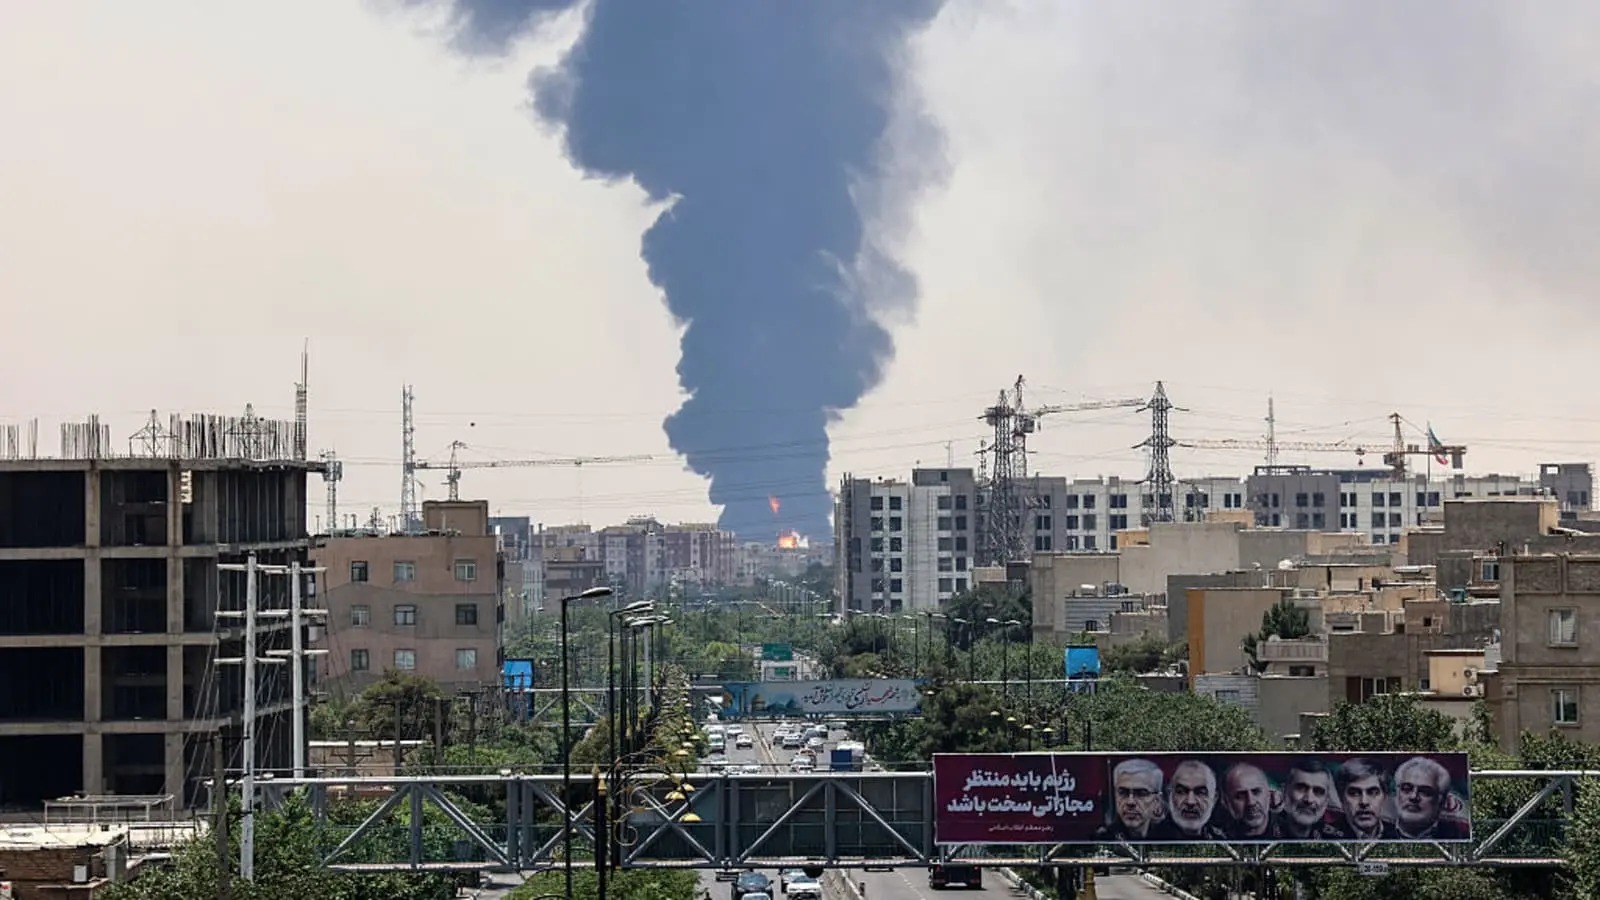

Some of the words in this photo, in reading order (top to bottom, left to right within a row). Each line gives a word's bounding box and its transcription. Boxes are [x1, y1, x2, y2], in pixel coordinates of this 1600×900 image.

[962, 768, 1010, 791] منتظر
[1010, 770, 1041, 792] باید
[947, 794, 986, 816] باشد
[988, 794, 1032, 812] سخت
[1032, 795, 1094, 817] مجازاتی
